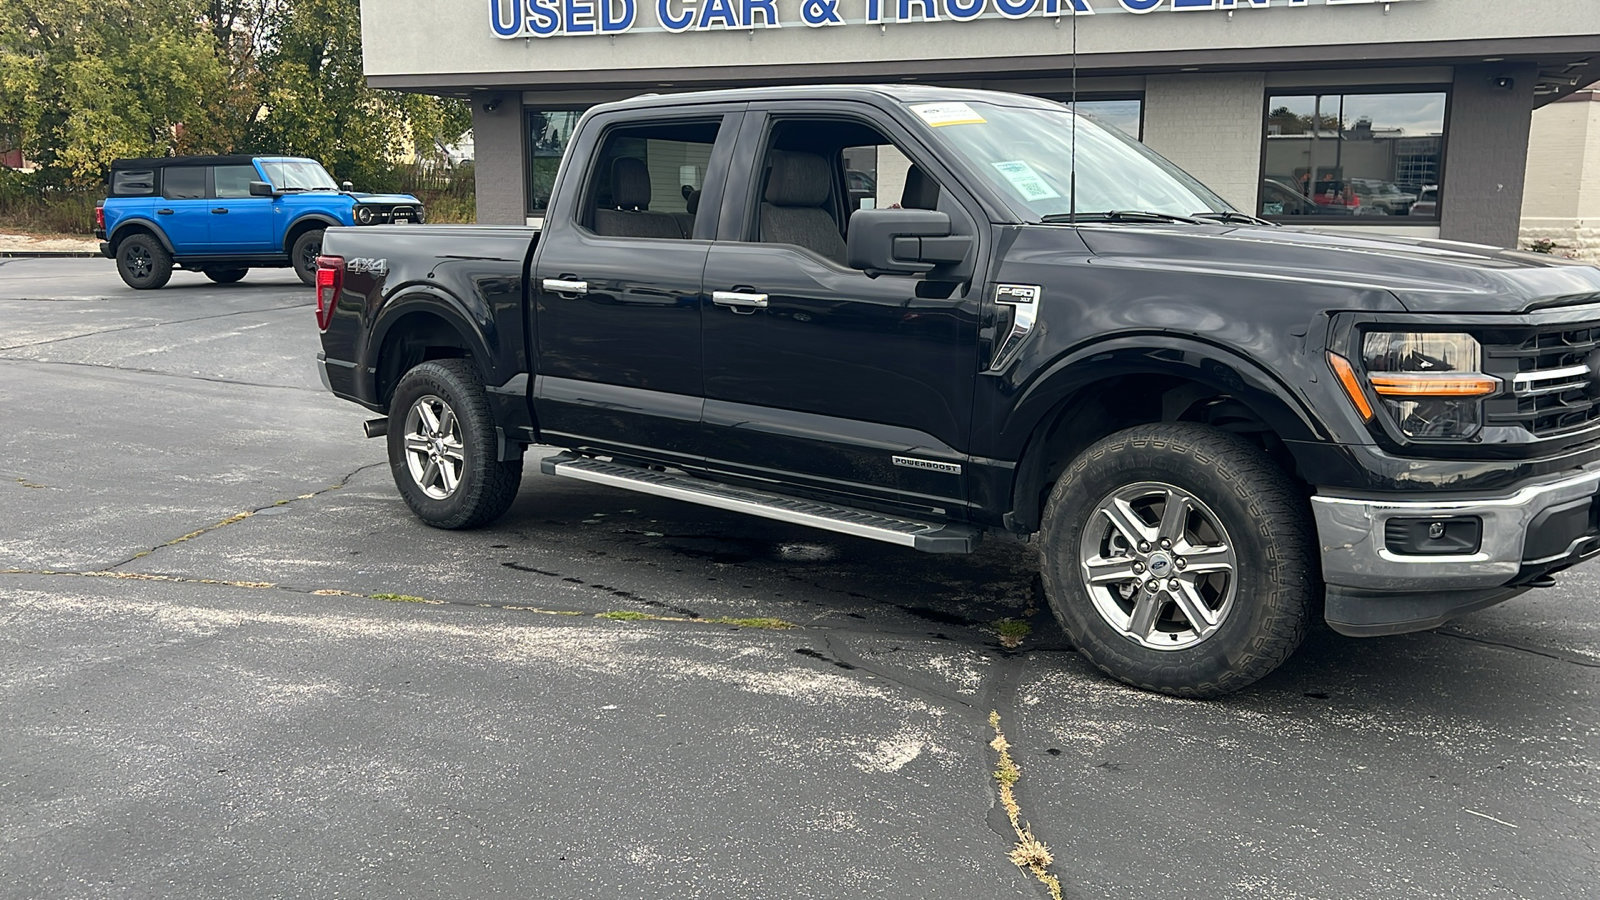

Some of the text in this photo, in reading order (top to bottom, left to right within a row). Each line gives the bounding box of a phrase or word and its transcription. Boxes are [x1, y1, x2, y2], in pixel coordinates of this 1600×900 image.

[488, 0, 638, 39] USED
[656, 0, 783, 33] CAR
[799, 0, 847, 27] &
[894, 457, 958, 472] POWERBOOST
